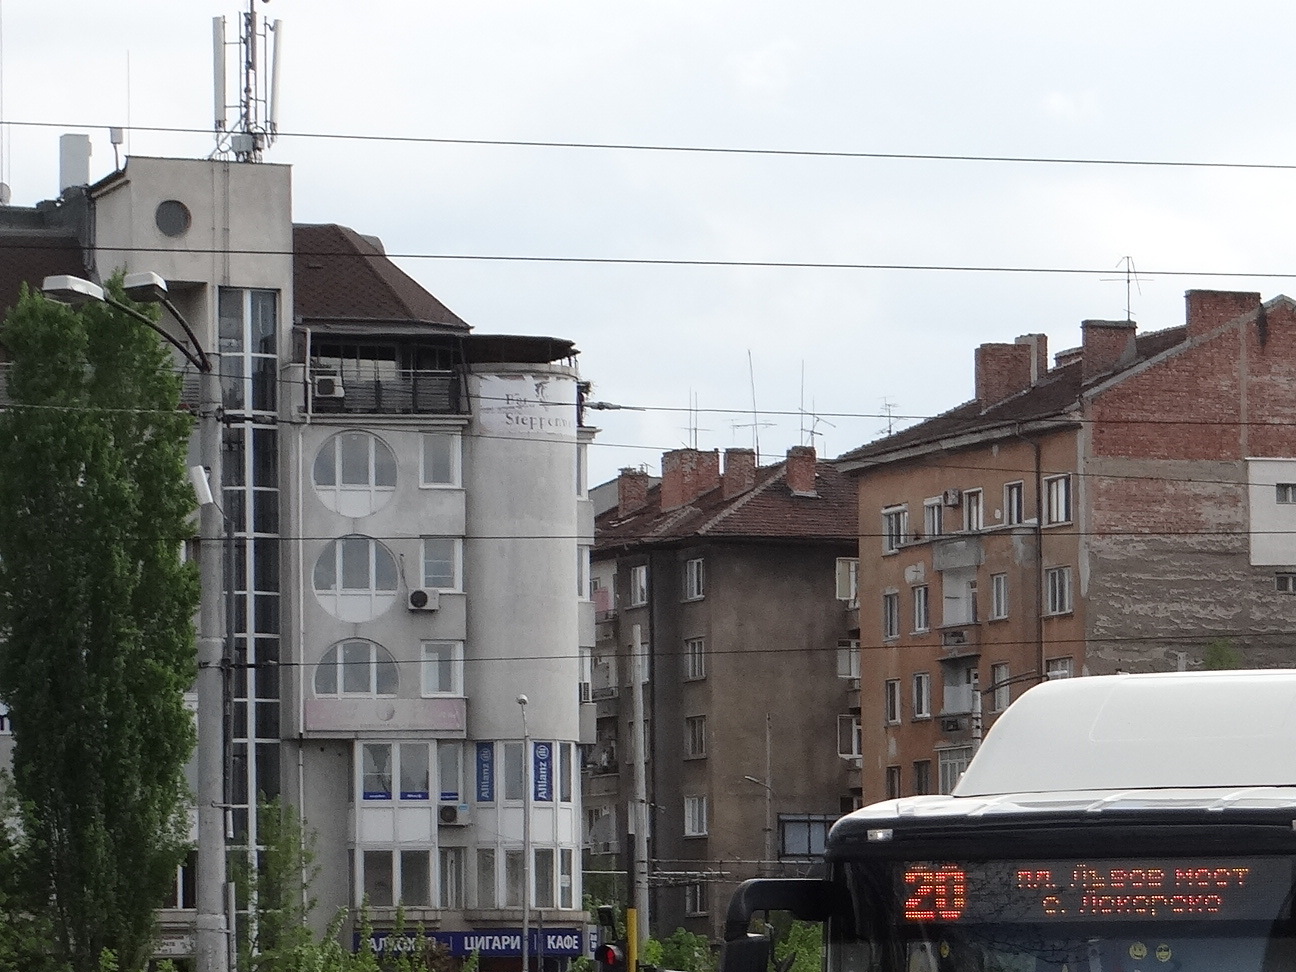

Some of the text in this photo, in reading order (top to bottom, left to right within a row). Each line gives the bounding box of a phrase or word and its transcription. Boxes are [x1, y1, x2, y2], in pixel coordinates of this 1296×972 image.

[481, 763, 490, 798] Allianz
[537, 761, 547, 799] Allianz
[905, 865, 965, 919] 20
[464, 934, 521, 951] ЦИГАРИ
[547, 934, 579, 950] КАФЕ
